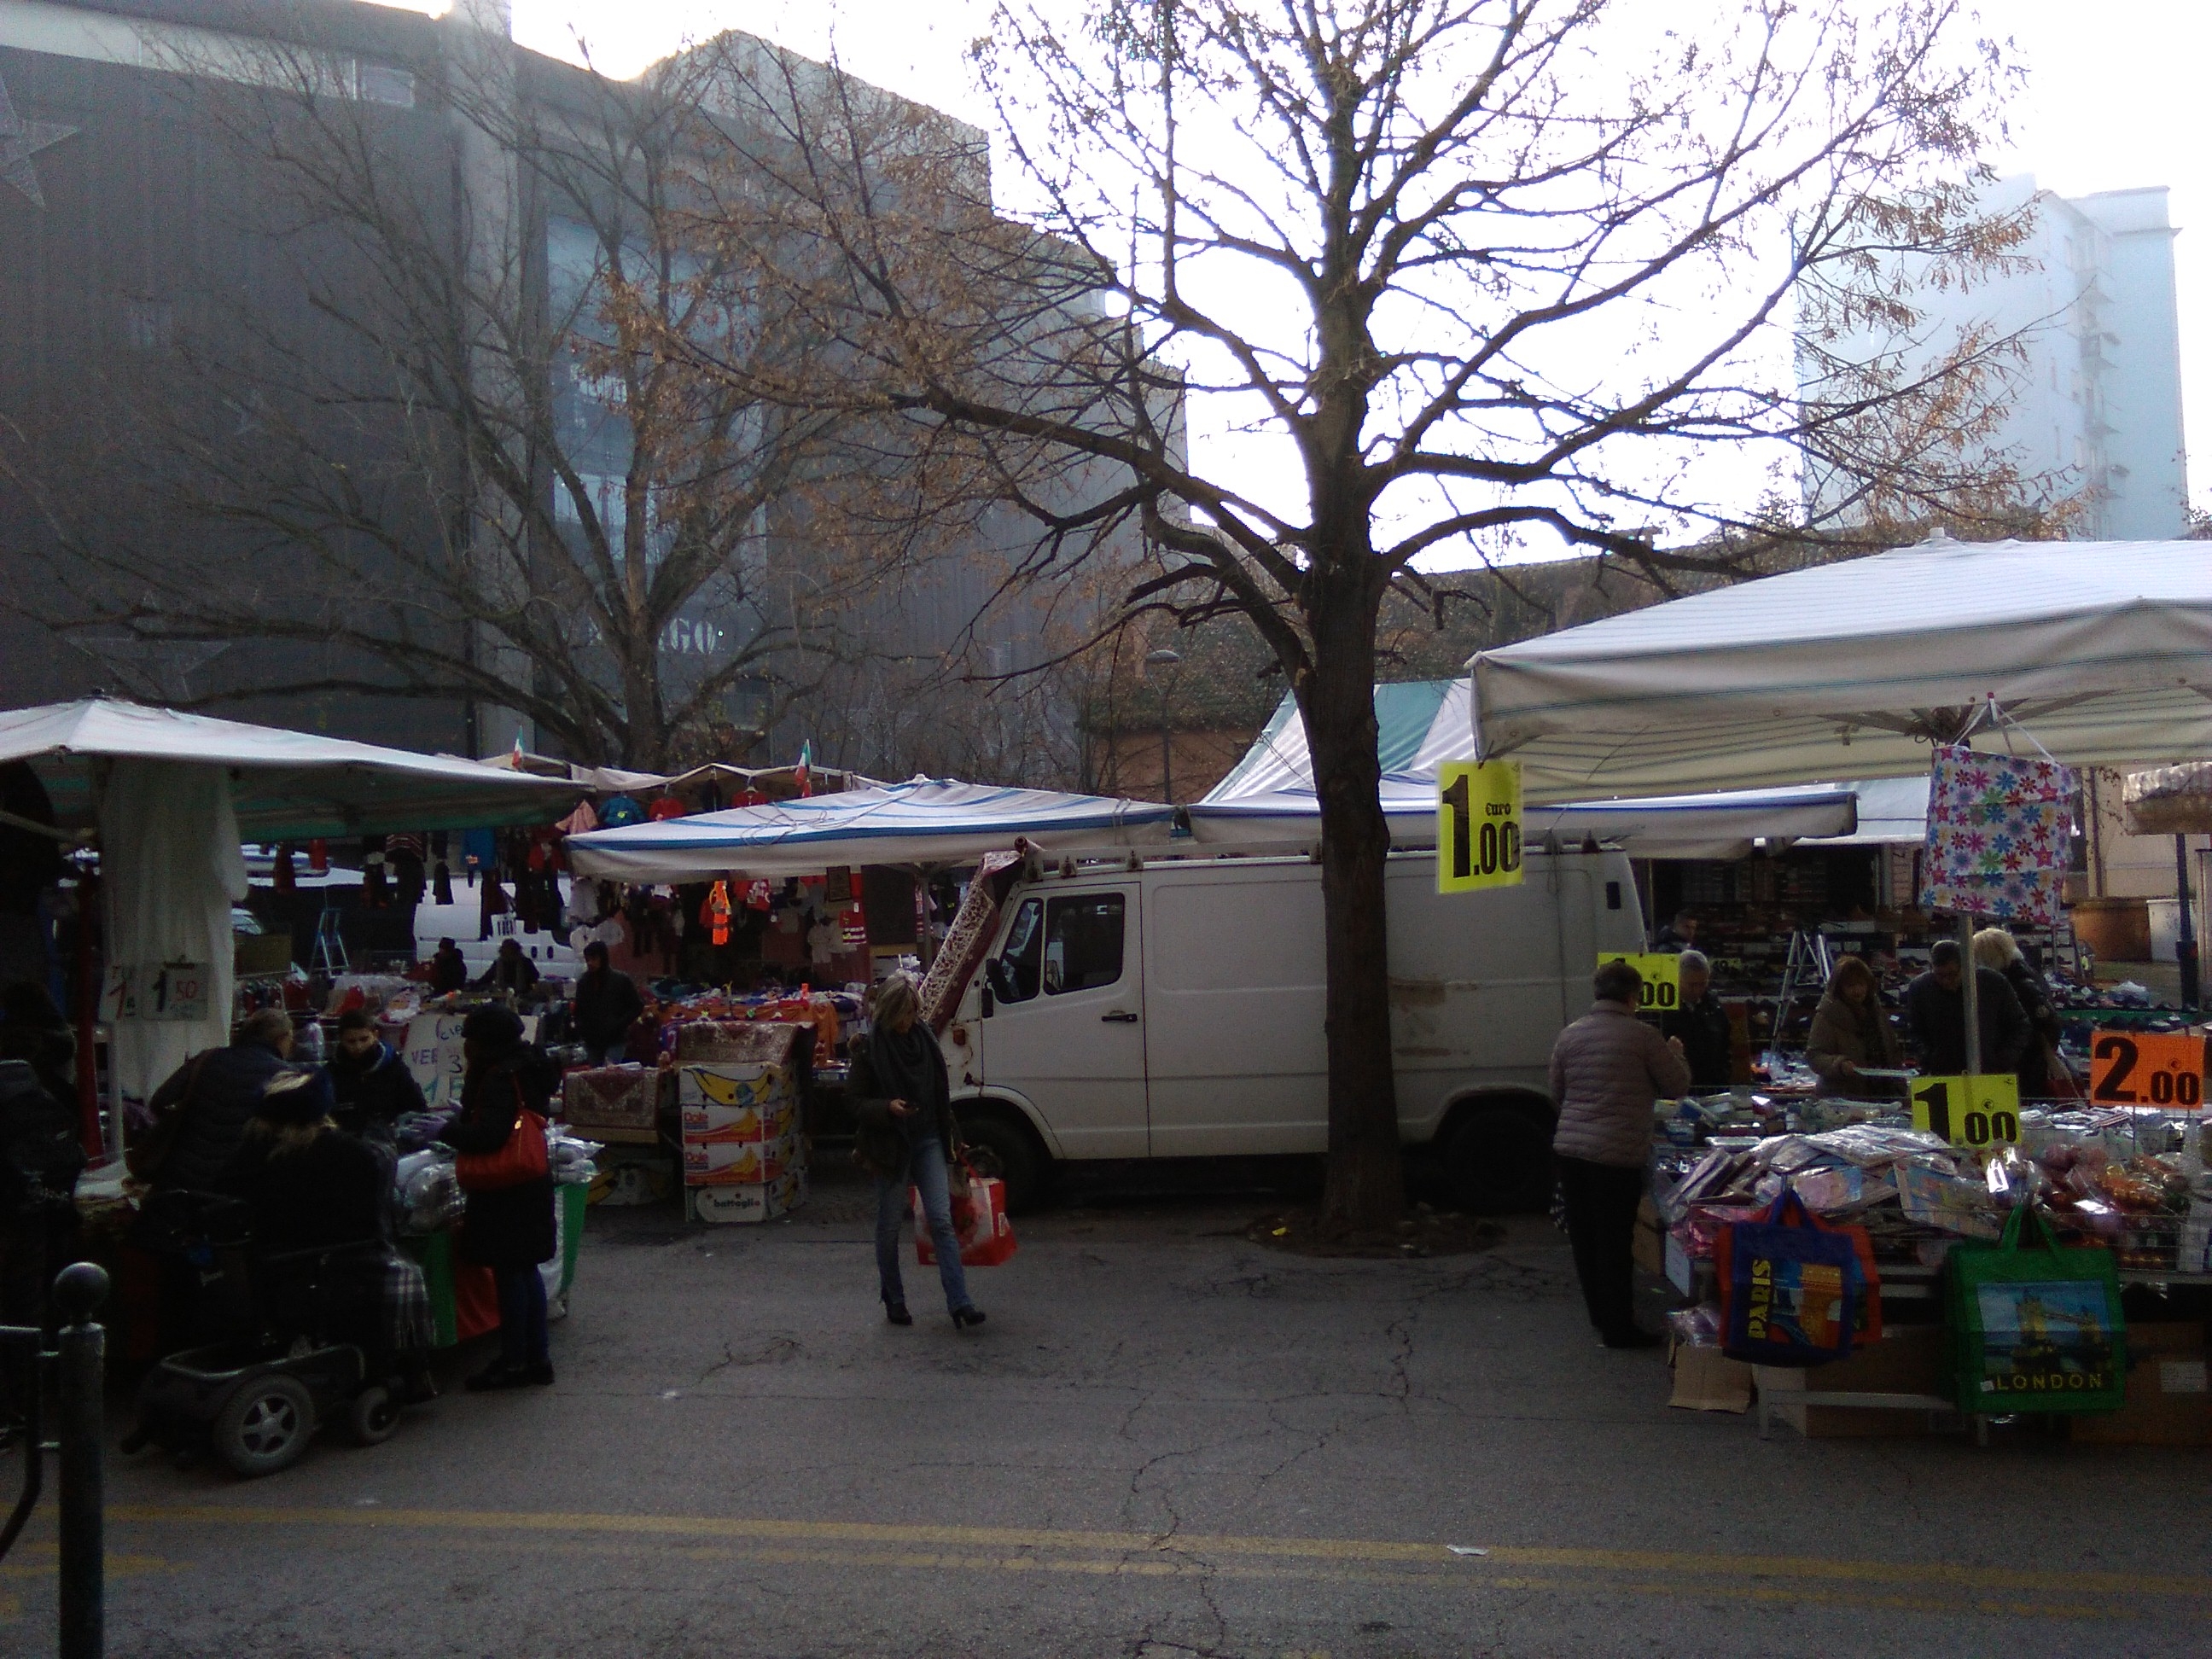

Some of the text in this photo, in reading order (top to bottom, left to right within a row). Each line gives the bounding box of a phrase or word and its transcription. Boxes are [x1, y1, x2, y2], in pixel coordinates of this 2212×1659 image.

[1442, 775, 1521, 878] 1.00
[2093, 1036, 2199, 1105] 2.00
[1747, 1259, 1771, 1340] PARIS
[1995, 1372, 2103, 1391] LONDON
